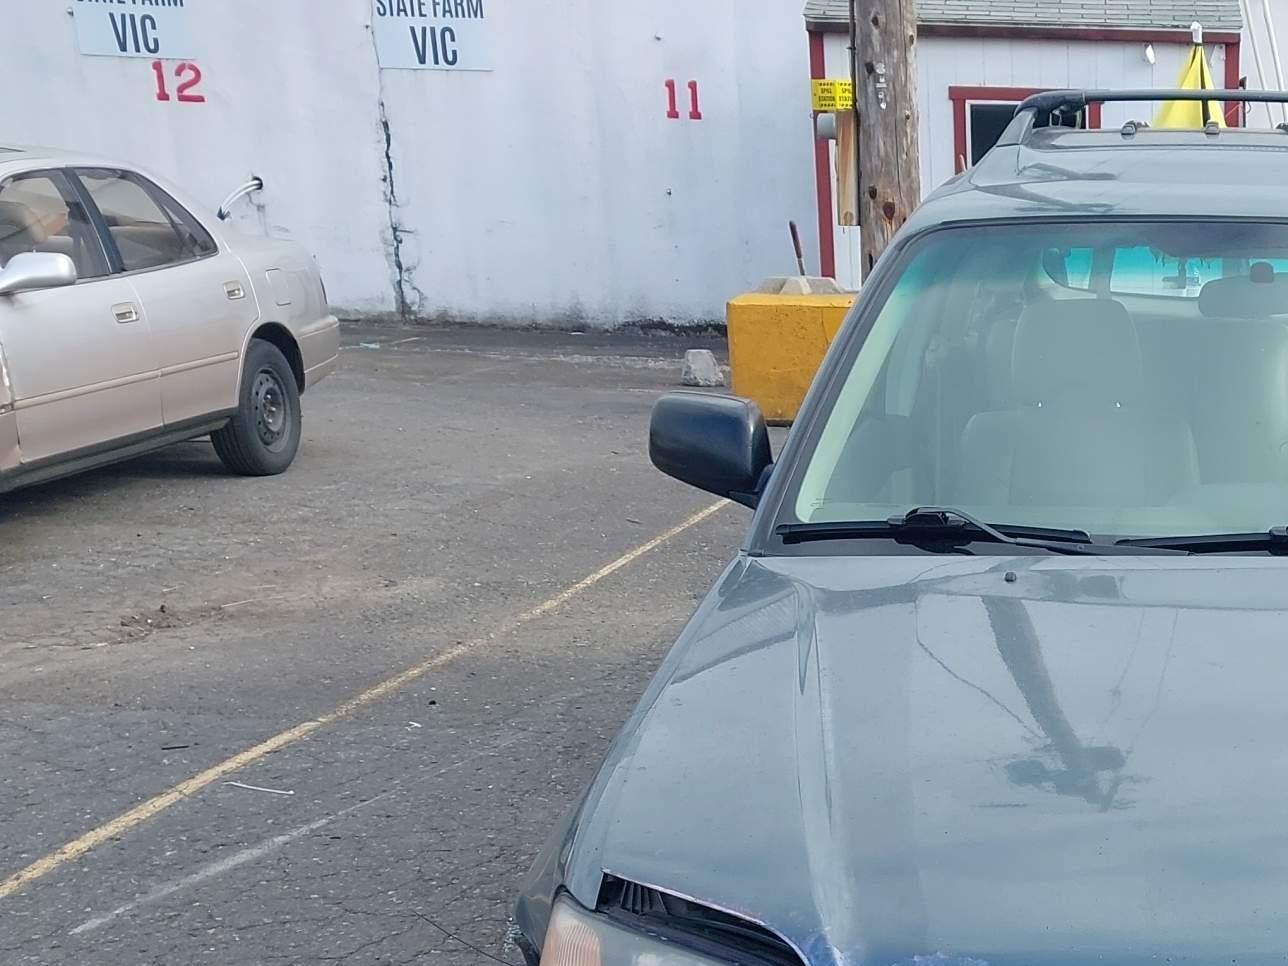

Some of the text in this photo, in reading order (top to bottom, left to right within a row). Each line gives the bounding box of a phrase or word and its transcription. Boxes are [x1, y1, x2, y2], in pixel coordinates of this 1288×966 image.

[376, 0, 485, 19] STATE FARM
[108, 12, 160, 54] VIC
[409, 26, 459, 66] VIC
[151, 60, 206, 103] 12
[664, 79, 702, 120] 11
